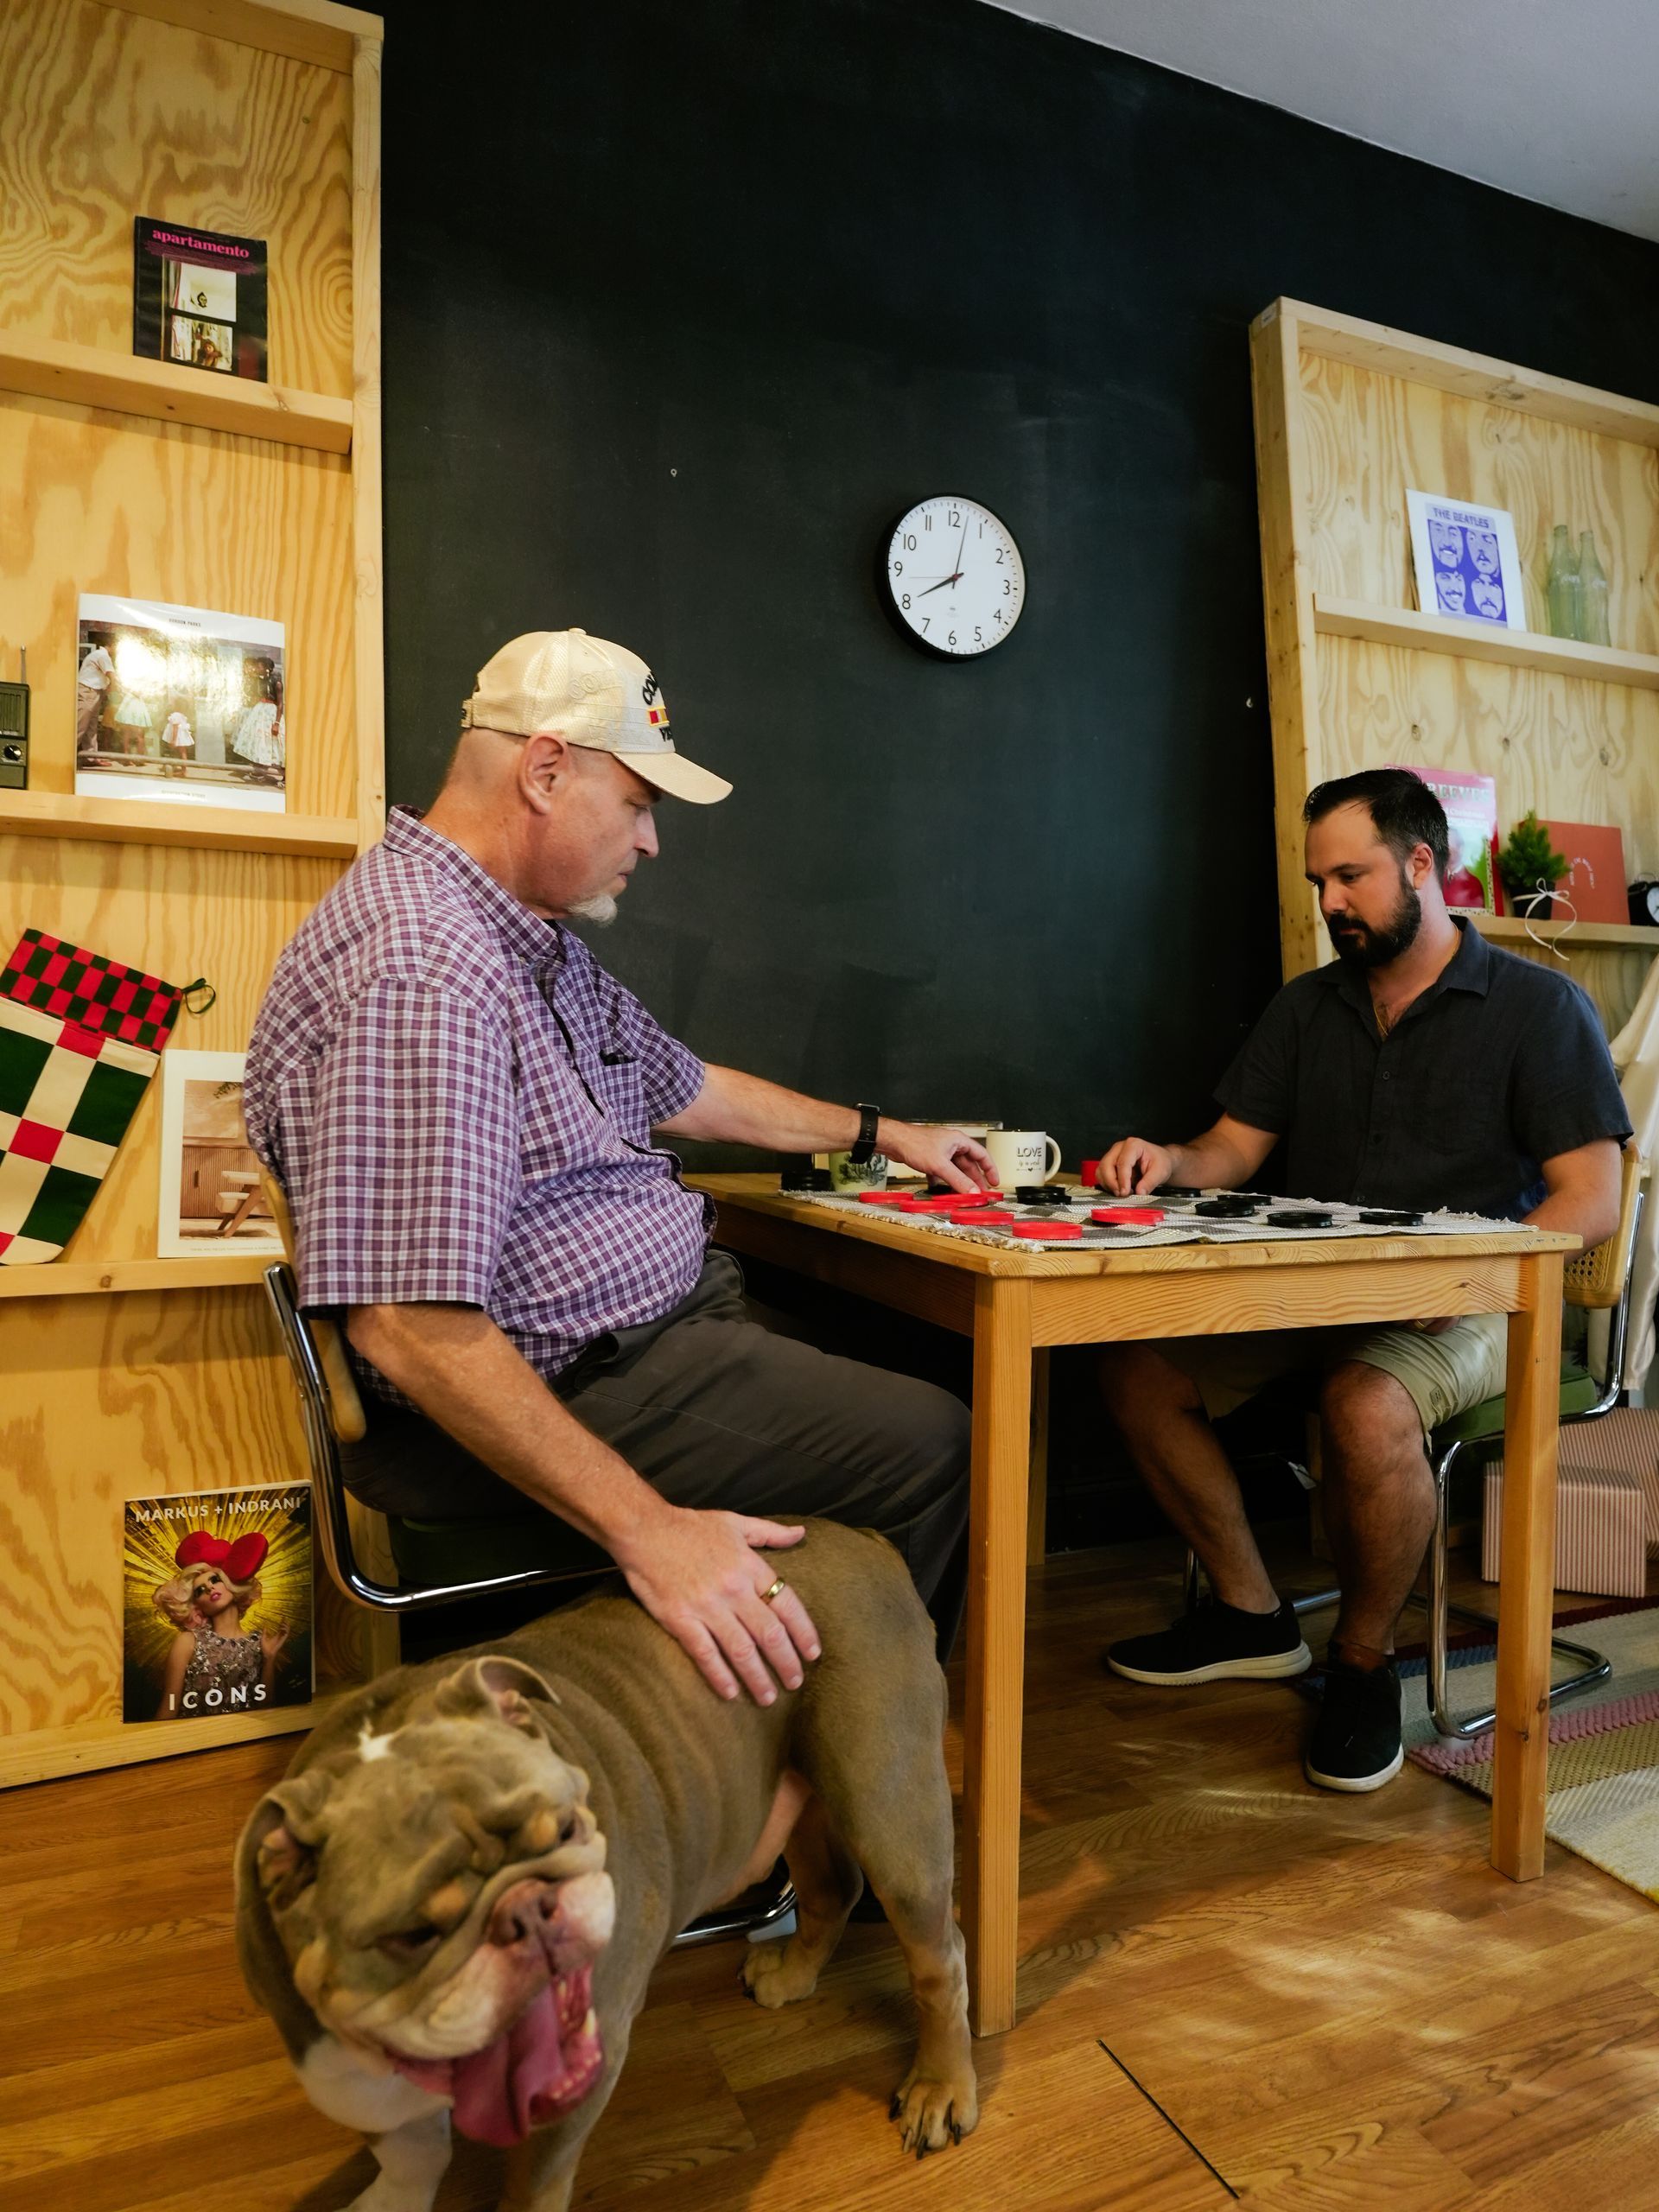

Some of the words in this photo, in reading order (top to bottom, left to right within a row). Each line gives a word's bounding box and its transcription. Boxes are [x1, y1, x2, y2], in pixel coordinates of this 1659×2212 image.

[151, 228, 250, 258] apartamento
[925, 514, 932, 531] 11
[948, 510, 961, 528] 12
[1433, 507, 1452, 520] THE
[1452, 512, 1489, 529] BEATLES
[903, 533, 917, 551] 10
[995, 548, 1004, 565] 2
[893, 561, 903, 577] 9
[1002, 579, 1011, 595] 3
[901, 593, 912, 610] 8
[993, 608, 1002, 624] 4
[922, 617, 931, 633] 7
[948, 630, 957, 646] 6
[974, 626, 982, 642] 5
[1017, 1147, 1042, 1158] LOVE
[135, 1504, 209, 1522] MARKUS
[229, 1497, 301, 1515] INDRANI
[169, 1684, 267, 1711] ICONS
